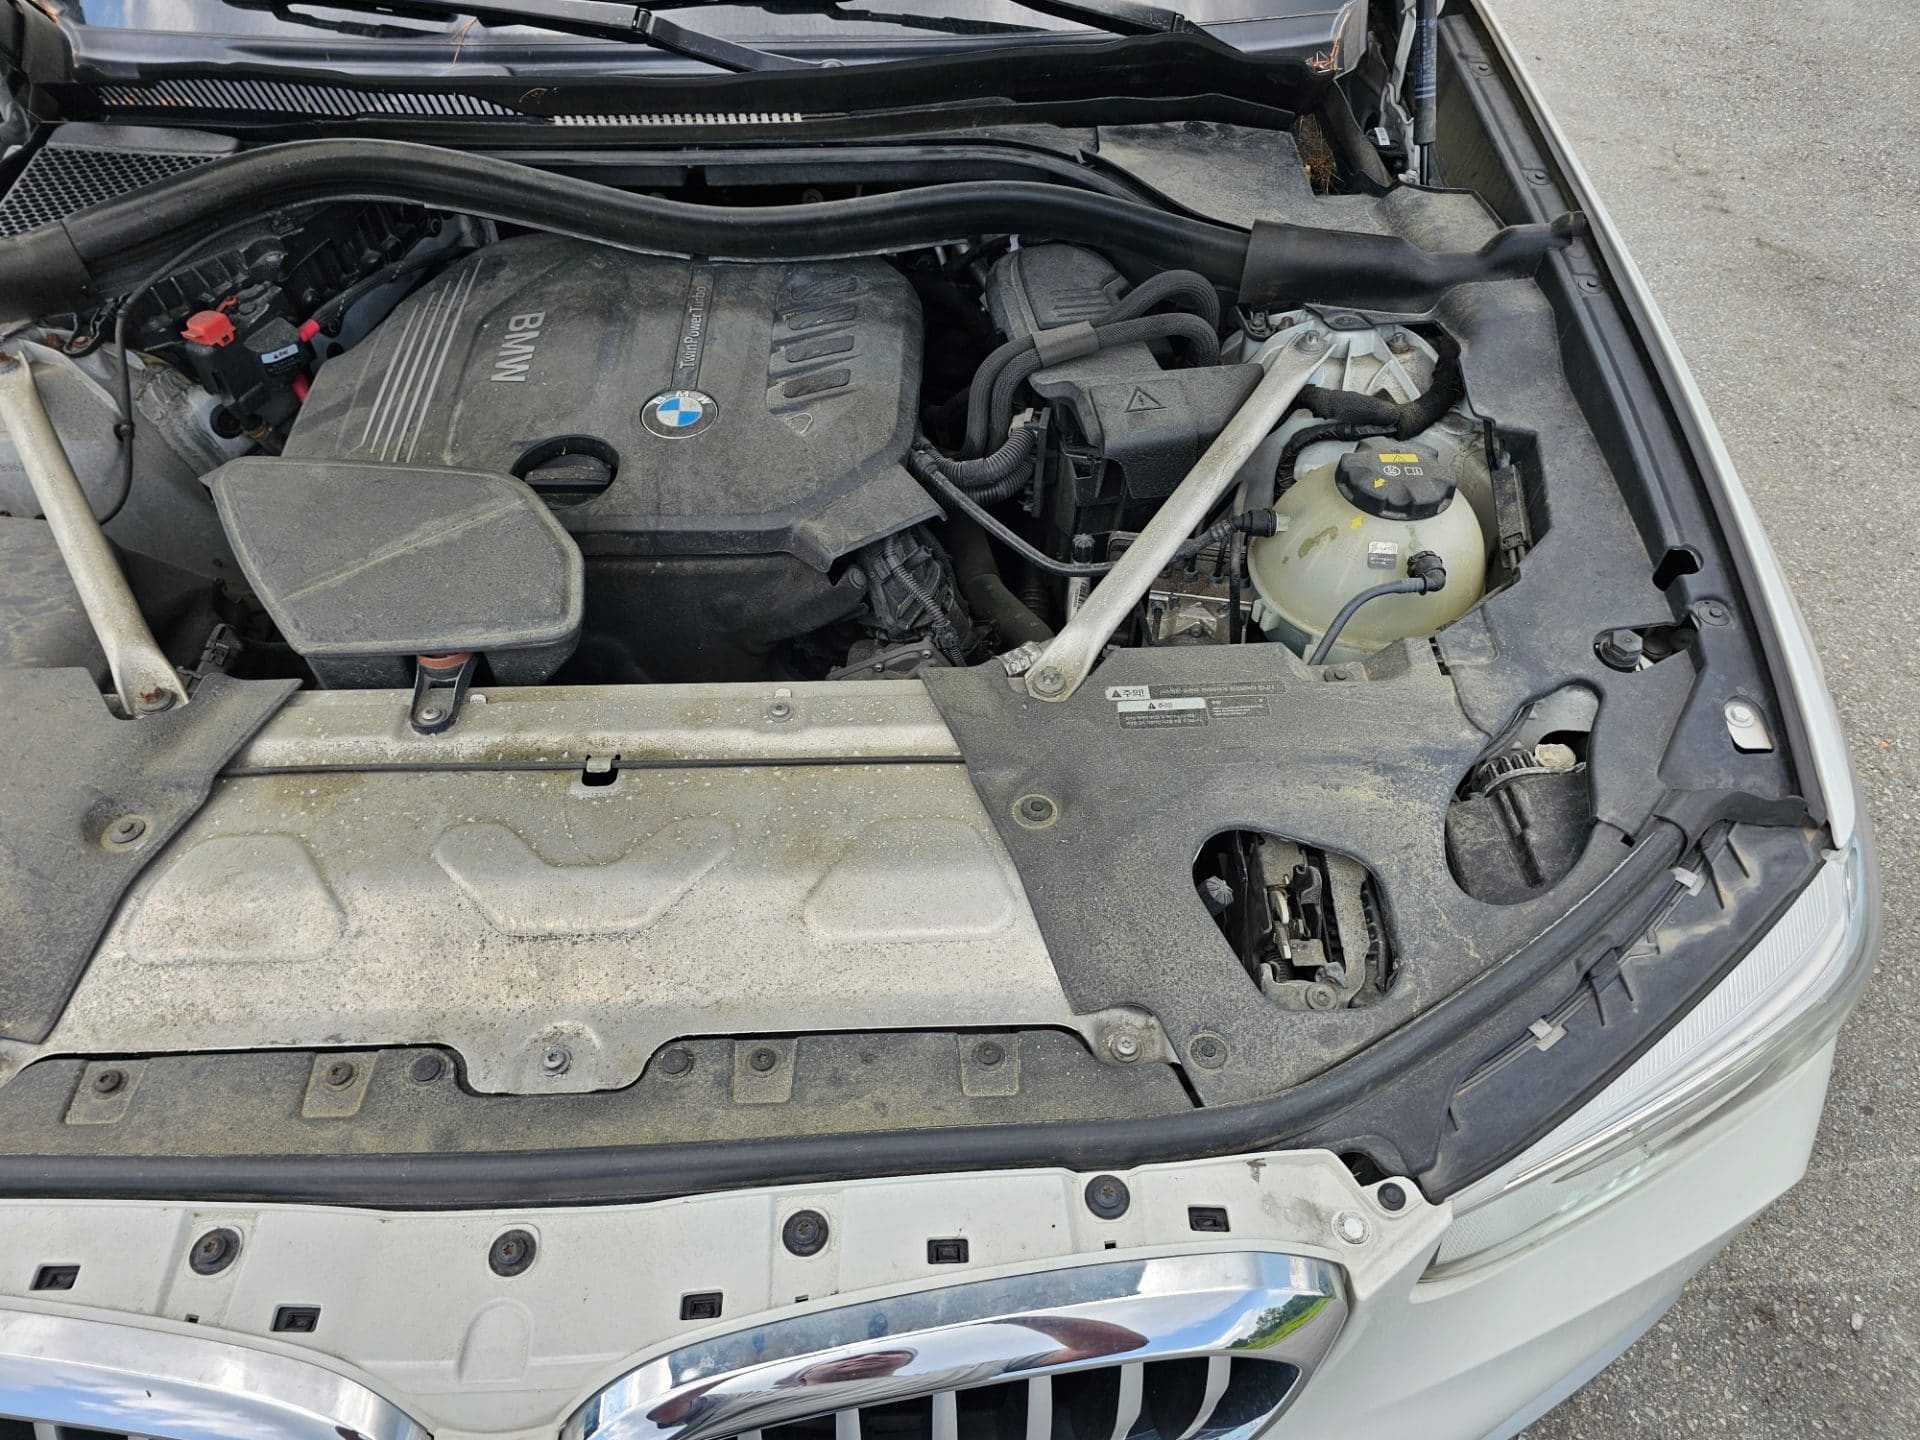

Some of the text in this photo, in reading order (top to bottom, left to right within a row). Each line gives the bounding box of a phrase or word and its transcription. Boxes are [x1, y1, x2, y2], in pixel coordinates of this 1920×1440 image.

[490, 311, 546, 382] BMW
[679, 286, 707, 369] TwinPower Turbo
